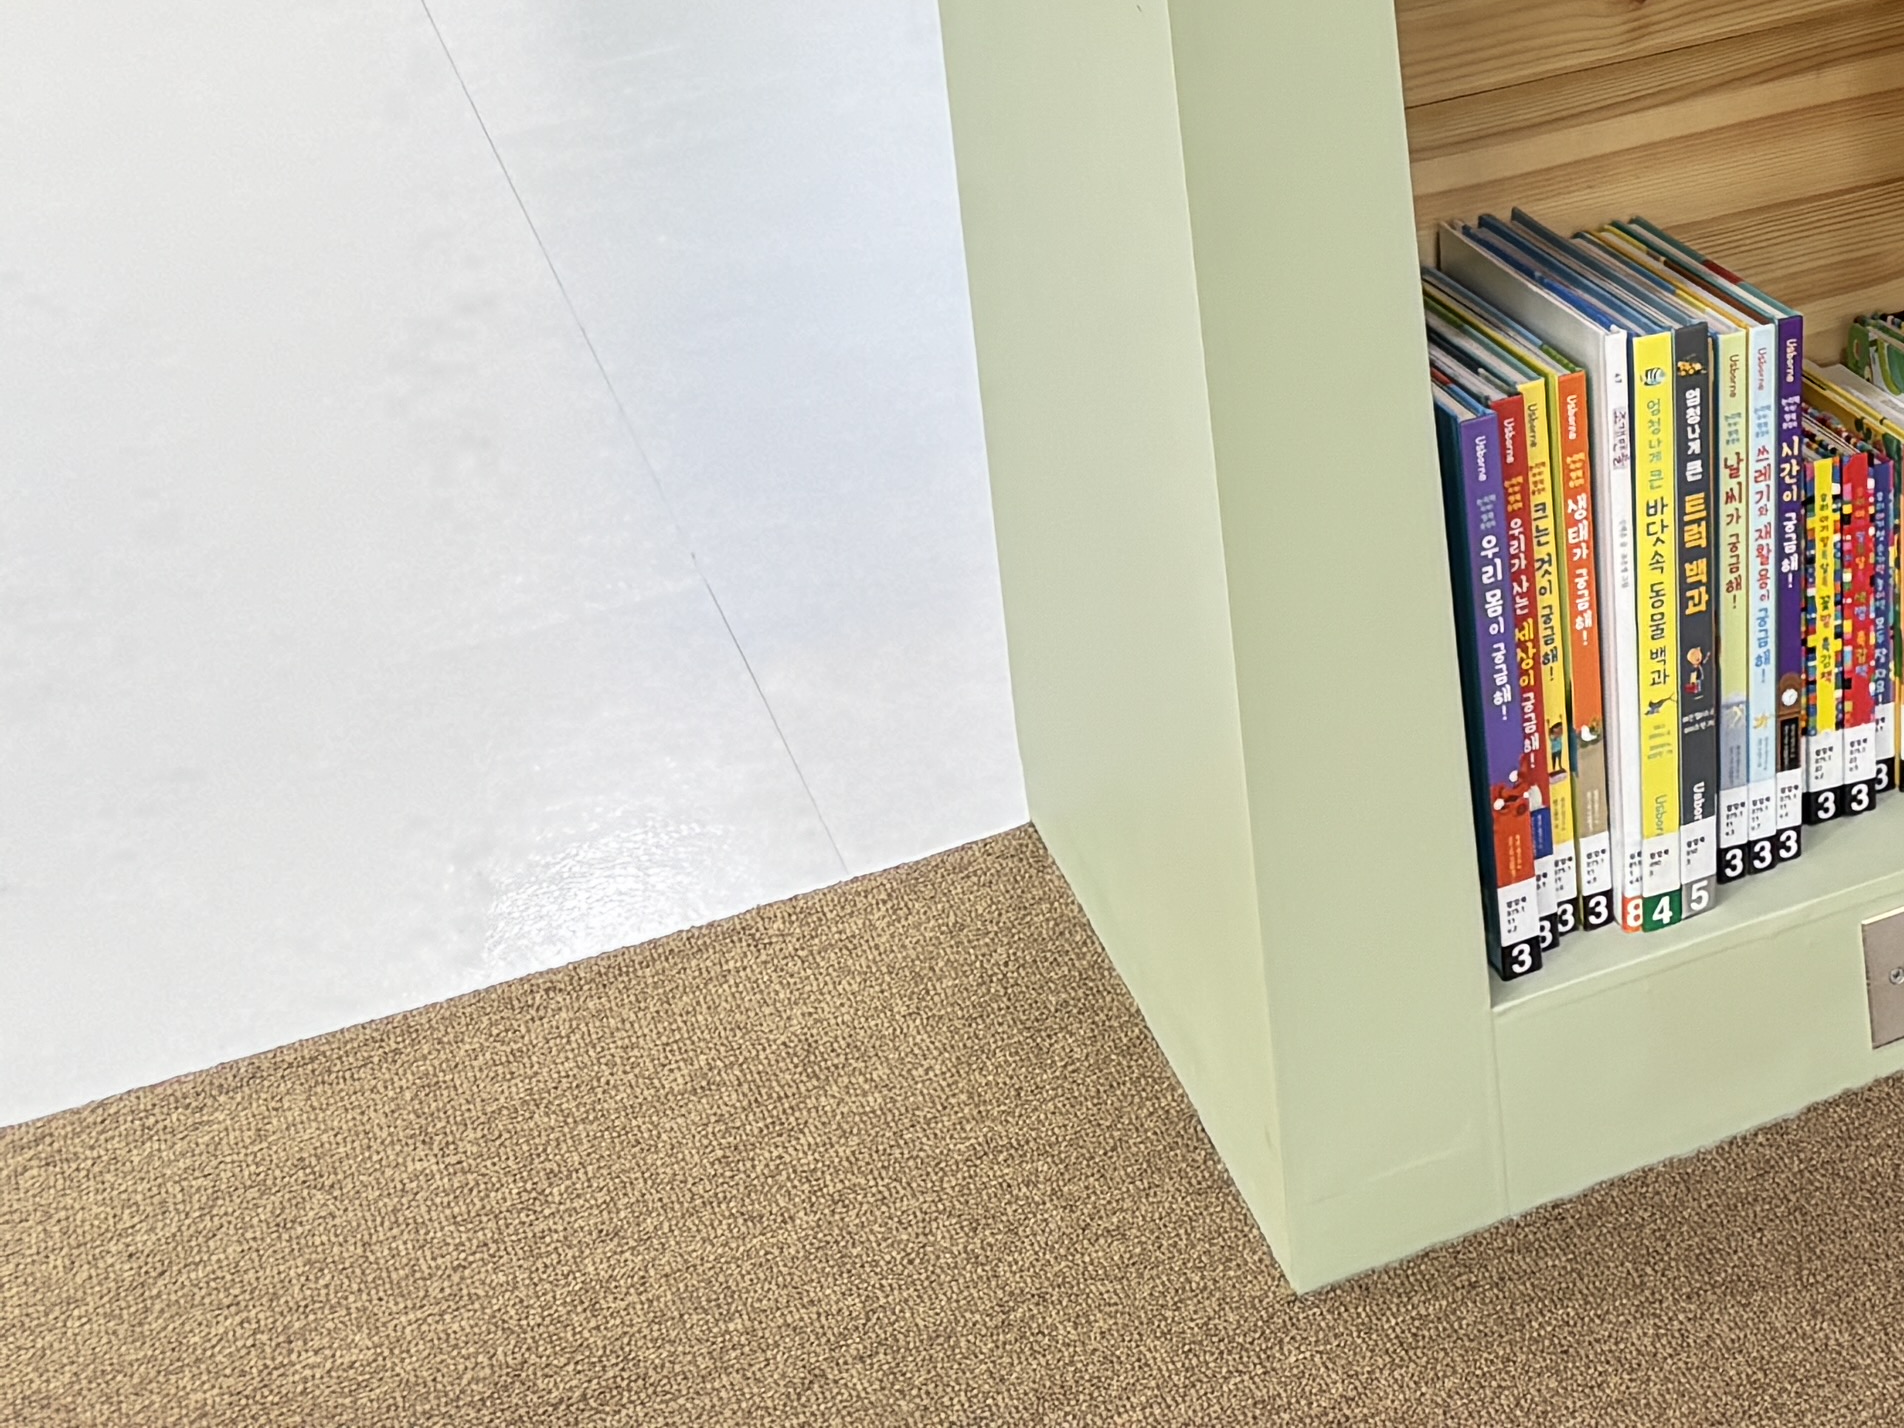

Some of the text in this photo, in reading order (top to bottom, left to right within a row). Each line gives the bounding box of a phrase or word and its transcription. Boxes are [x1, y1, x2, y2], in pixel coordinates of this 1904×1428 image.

[1532, 500, 1551, 546] 크는
[1565, 492, 1594, 646] 생태가 궁금해!
[1641, 398, 1671, 687] 엄청나게 큰 바닷속 동물 백과
[1682, 387, 1710, 617] 엄청나게 큰 트럭 백과
[1721, 450, 1745, 611] 날씨가 궁금해!
[1753, 444, 1774, 683] 쓰레기와 재활용이 궁금해!
[1779, 433, 1801, 589] 시간이 궁금해!
[1478, 534, 1510, 721] 우리 몸이 궁금해!
[1507, 517, 1541, 770] 우리가 사는 세상이 궁금해!
[1539, 604, 1558, 682] 궁금해!
[1512, 943, 1533, 975] 3
[1650, 894, 1675, 926] 4
[1690, 879, 1711, 912] 5
